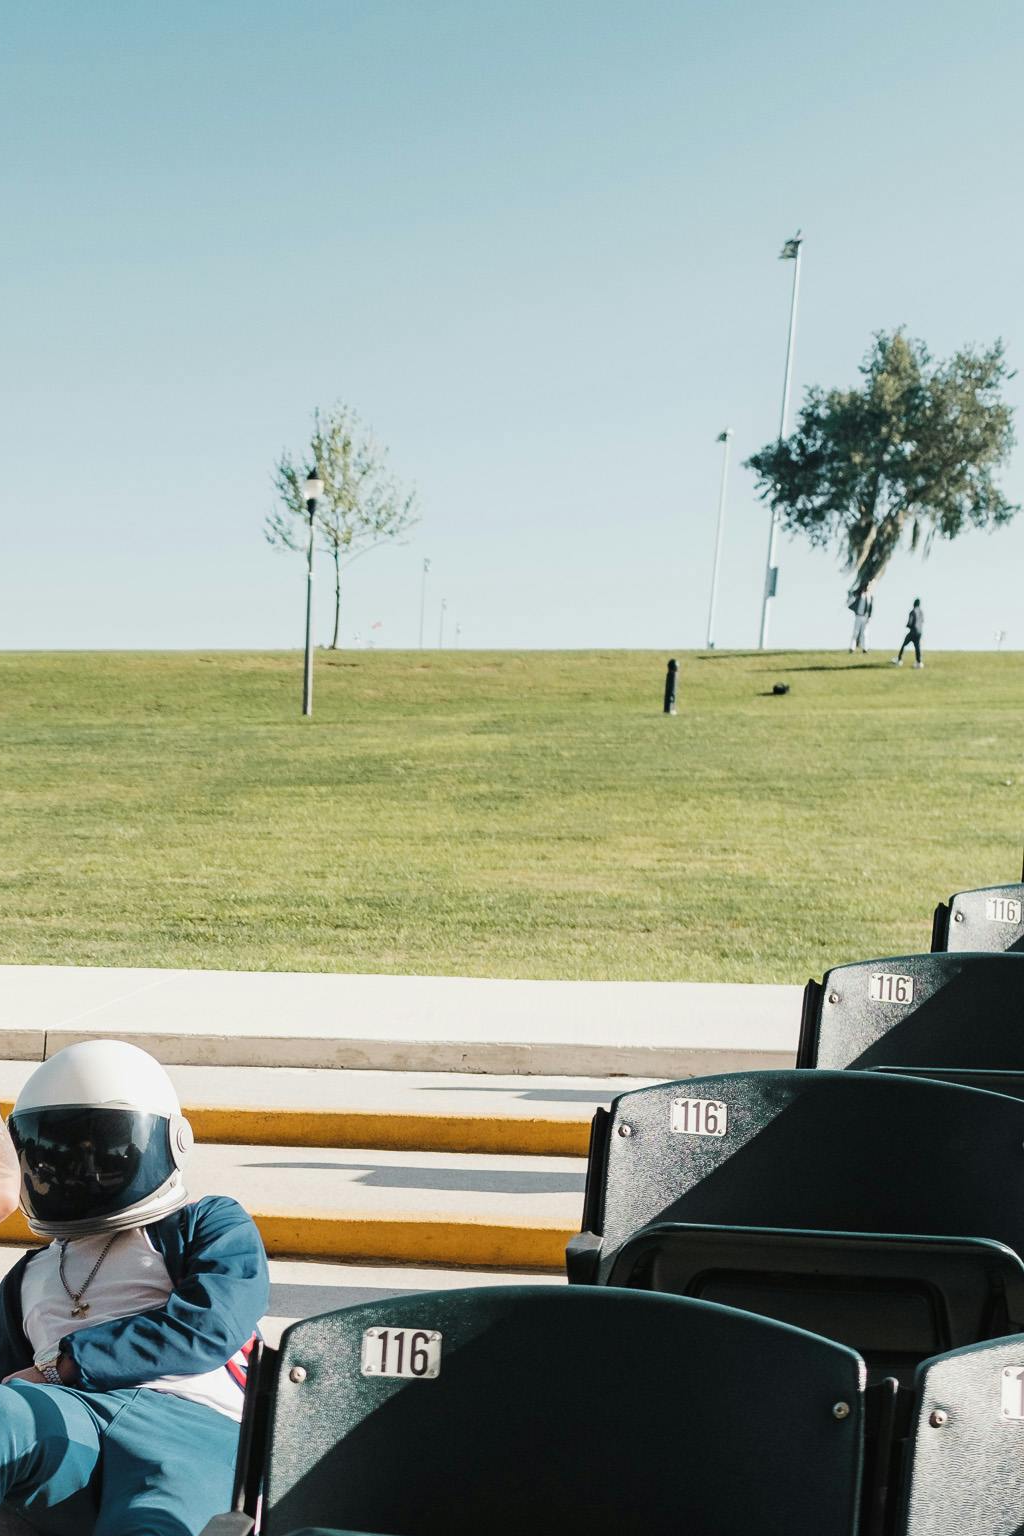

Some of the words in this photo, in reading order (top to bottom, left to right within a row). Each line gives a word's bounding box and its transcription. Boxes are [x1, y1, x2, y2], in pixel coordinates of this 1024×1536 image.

[992, 900, 1016, 921] 116
[878, 975, 906, 1002] 116
[680, 1100, 718, 1134] 116
[377, 1330, 429, 1375] 116
